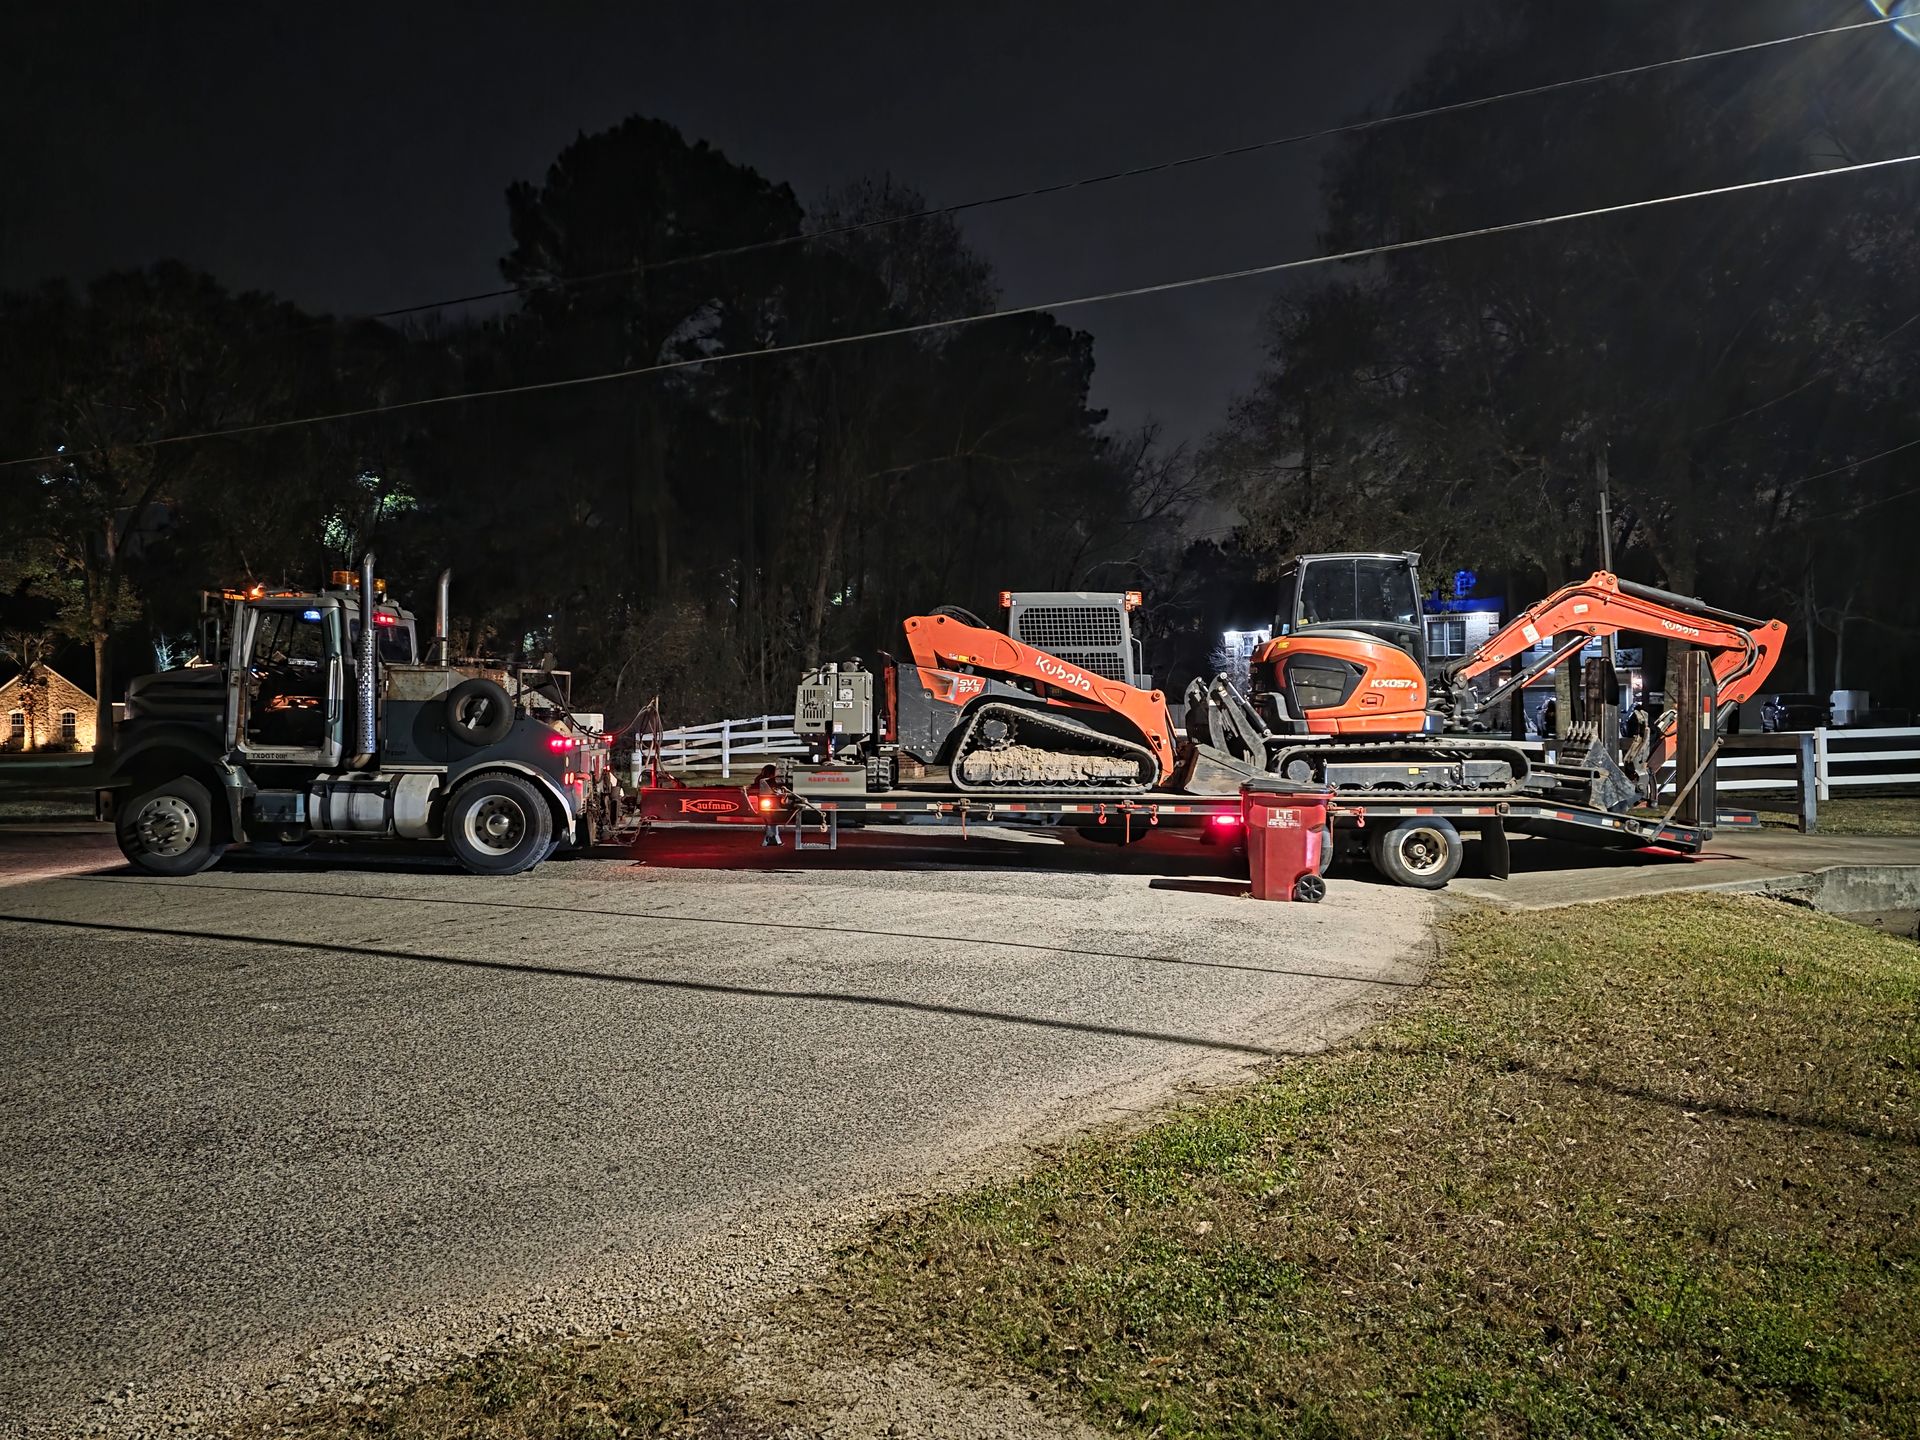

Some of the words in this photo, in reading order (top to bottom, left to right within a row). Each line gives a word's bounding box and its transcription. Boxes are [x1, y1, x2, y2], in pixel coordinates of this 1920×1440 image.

[1662, 619, 1699, 636] Kubota
[1035, 655, 1091, 692] Kubota
[959, 679, 981, 687] SVL
[679, 799, 735, 812] Kaufman
